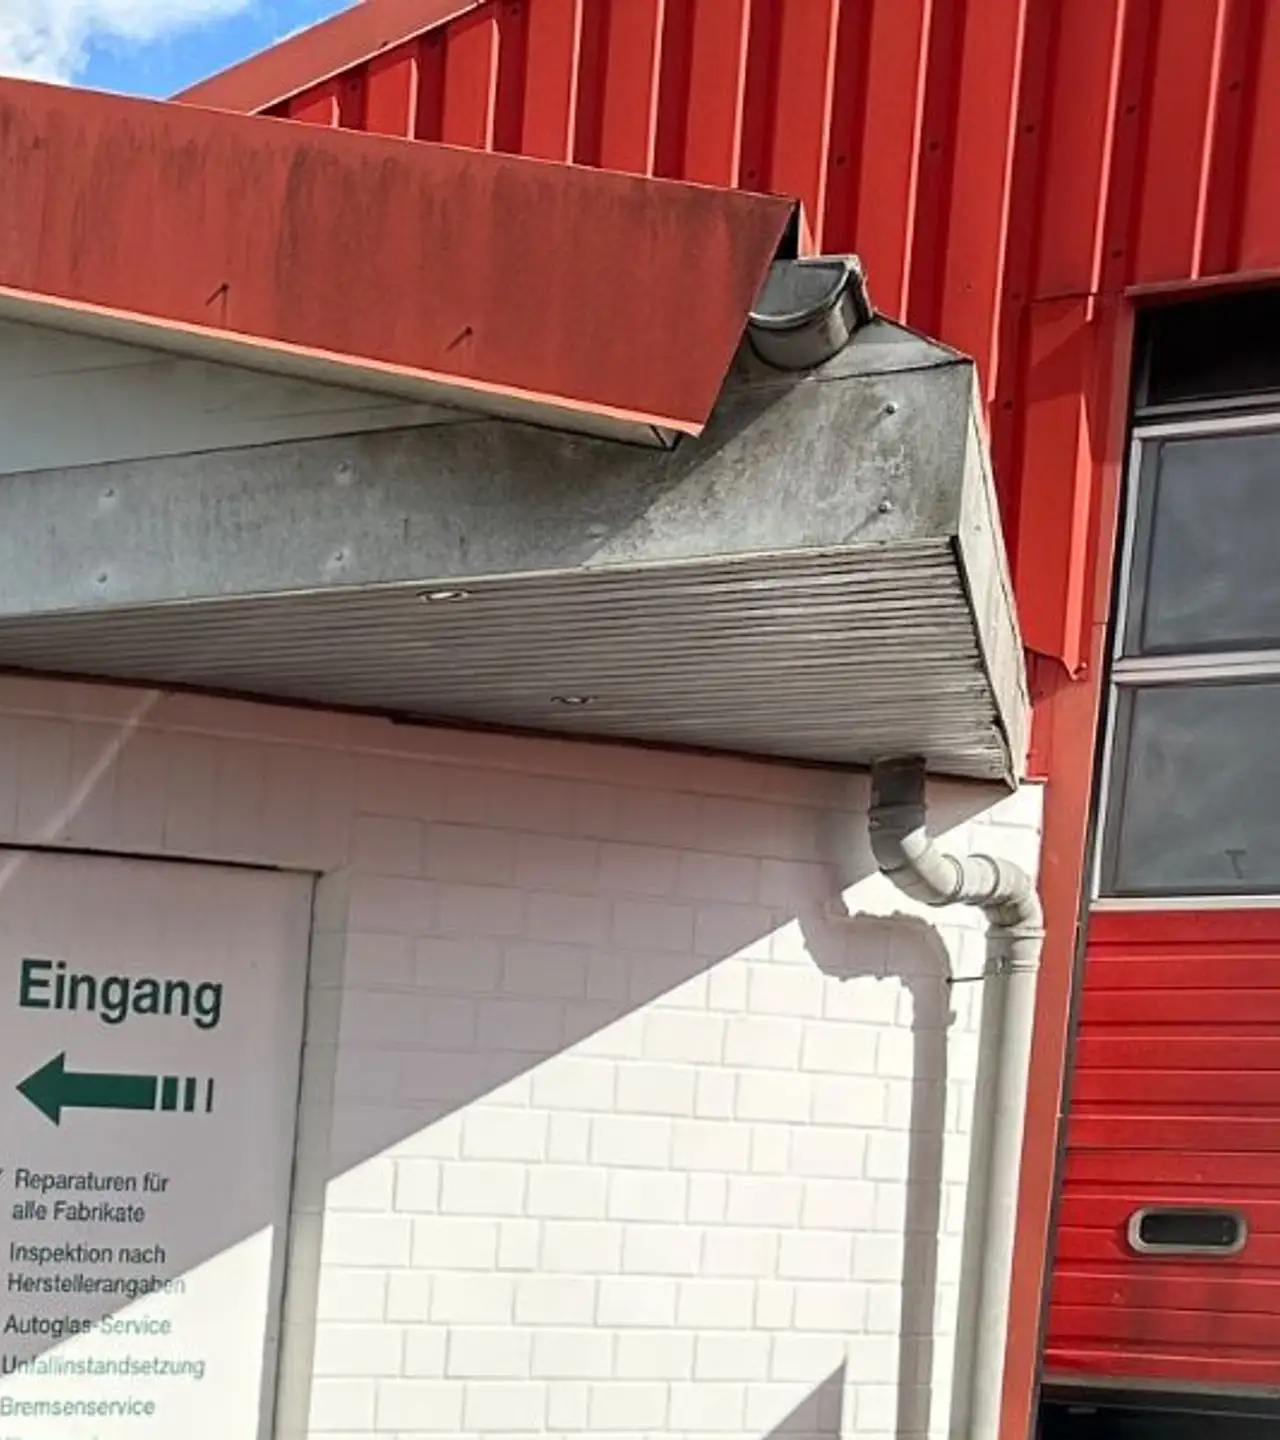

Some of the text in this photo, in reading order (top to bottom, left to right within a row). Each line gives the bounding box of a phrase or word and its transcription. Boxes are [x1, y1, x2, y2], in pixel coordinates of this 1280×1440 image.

[18, 958, 224, 1029] Eingang
[14, 1168, 170, 1194] Reparaturen für
[12, 1200, 146, 1223] alle Fabrikate
[9, 1241, 166, 1265] Inspektion nach
[7, 1272, 187, 1299] Herstellerangaben
[3, 1313, 172, 1338] Autoglas-Service
[1, 1354, 206, 1380] Unfallinstandsetzung
[0, 1396, 156, 1417] Bremsenservice
